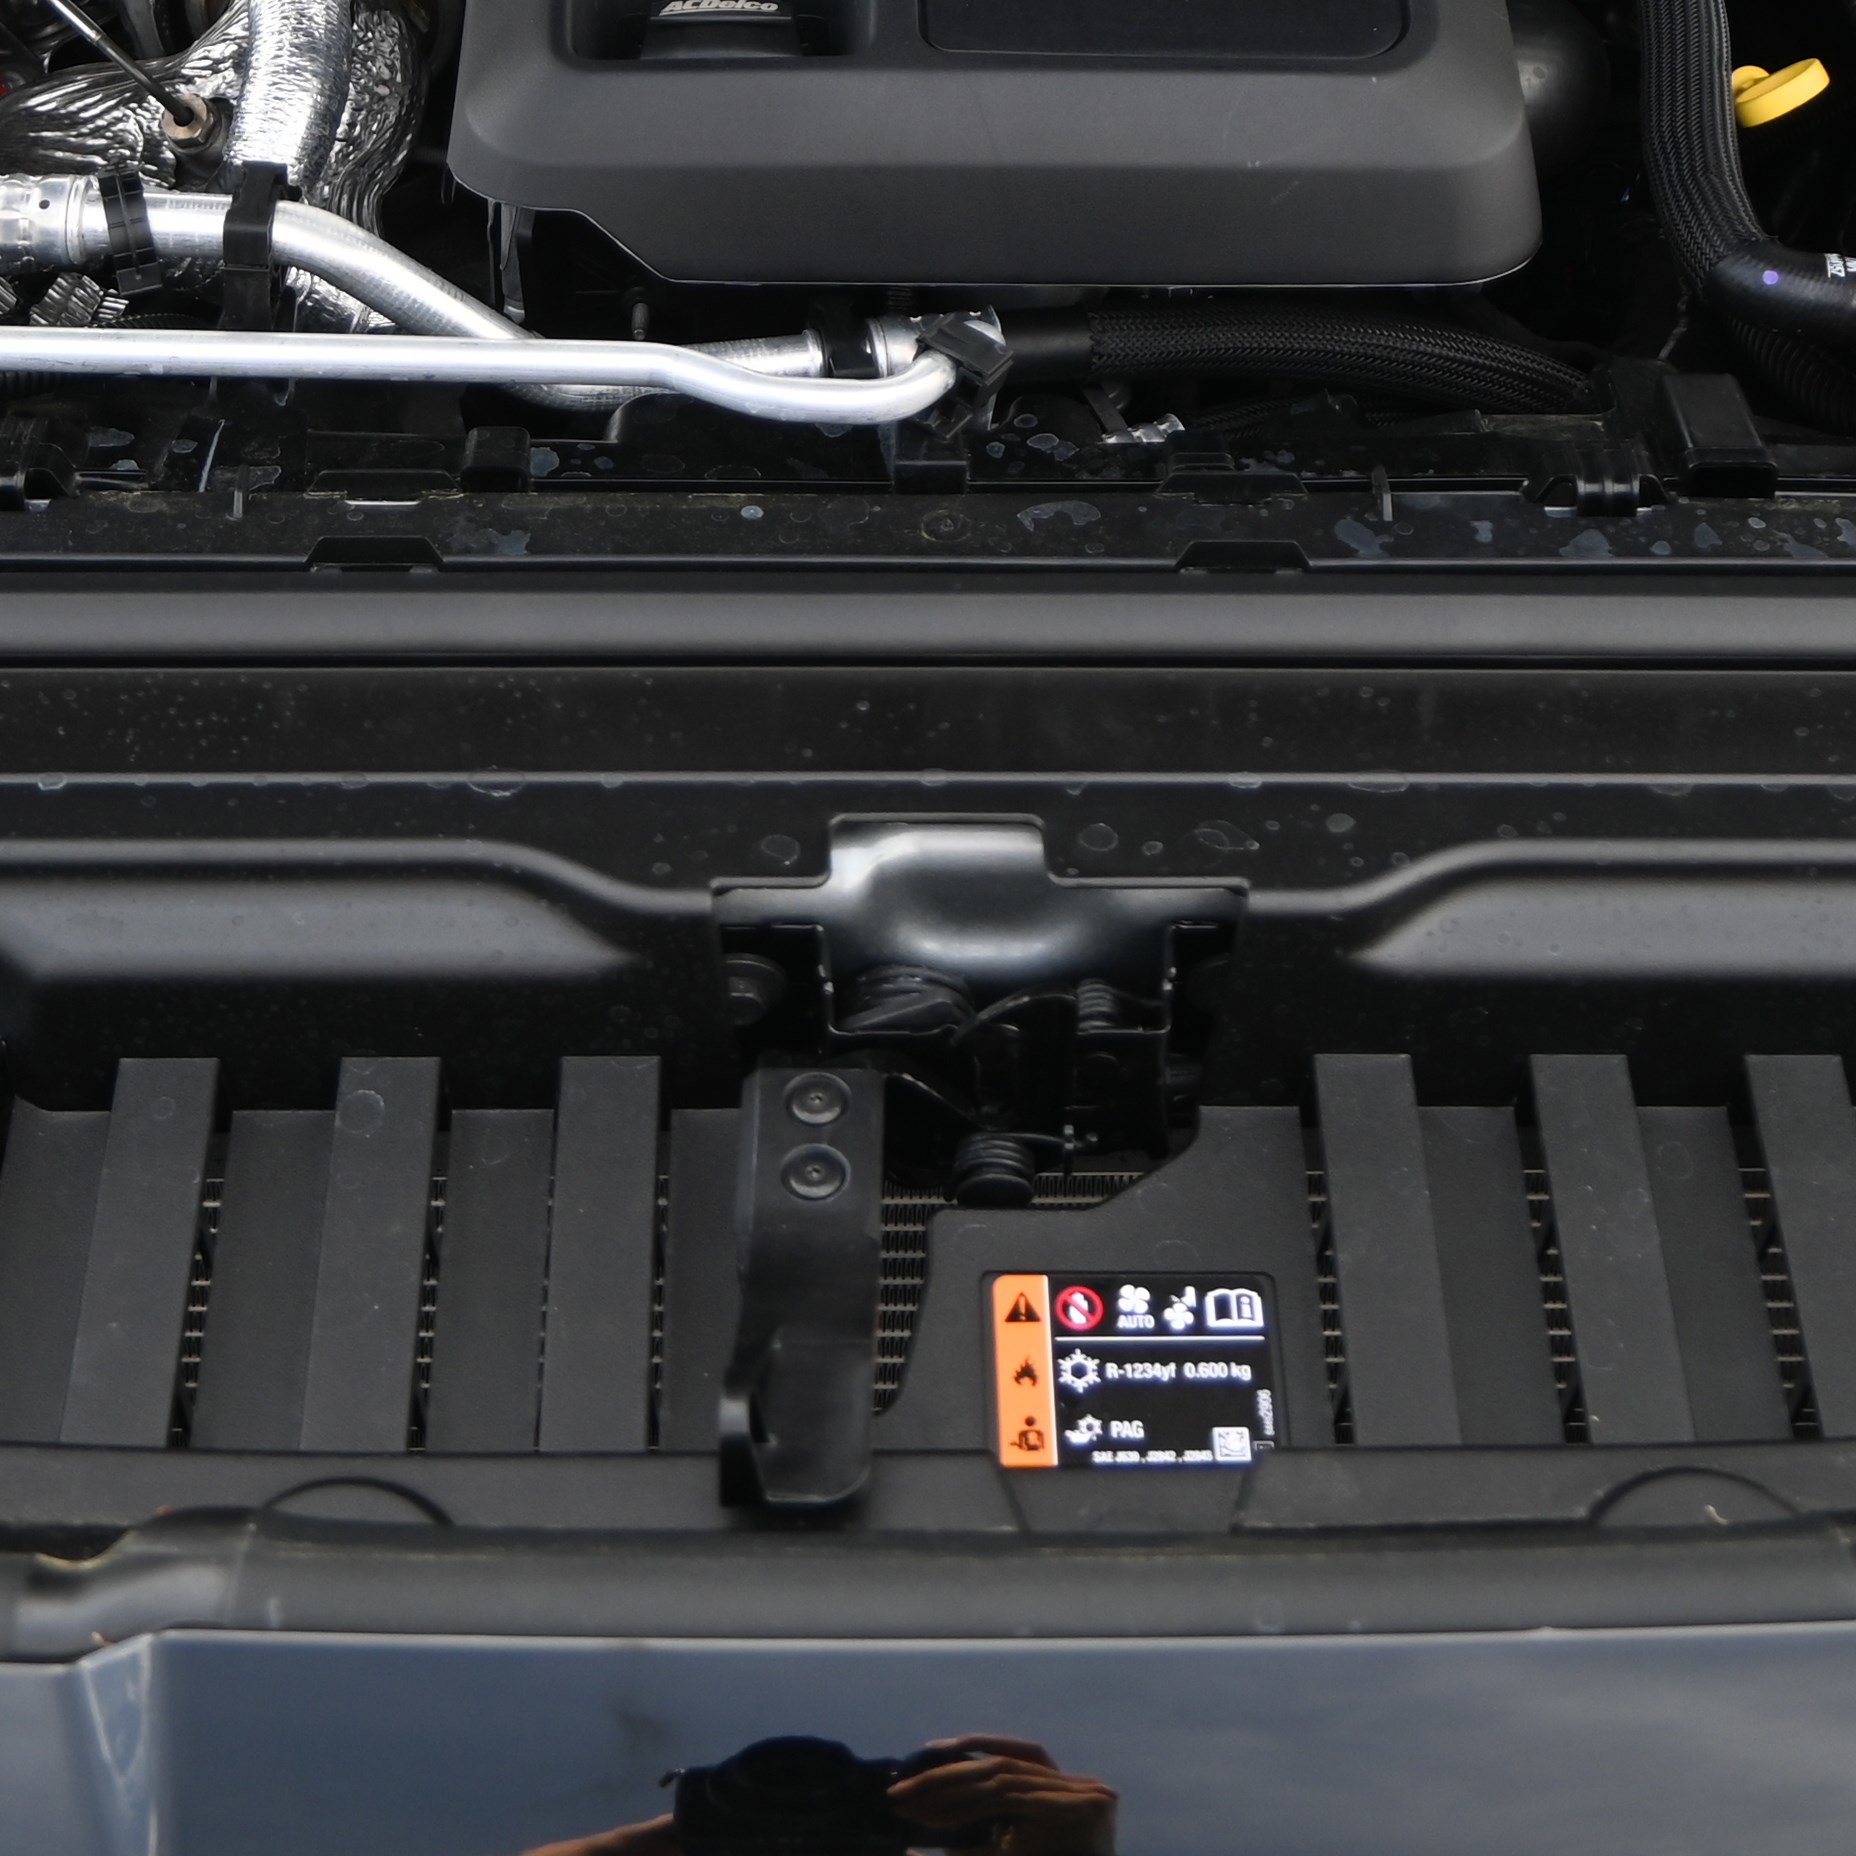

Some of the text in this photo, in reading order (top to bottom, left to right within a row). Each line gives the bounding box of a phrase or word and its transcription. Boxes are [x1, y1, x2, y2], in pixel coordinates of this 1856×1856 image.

[1117, 1315, 1155, 1329] AUTO
[1105, 1362, 1252, 1381] R-1234yf 0.600 kg
[1110, 1420, 1144, 1439] PAG
[1092, 1450, 1114, 1463] SAE
